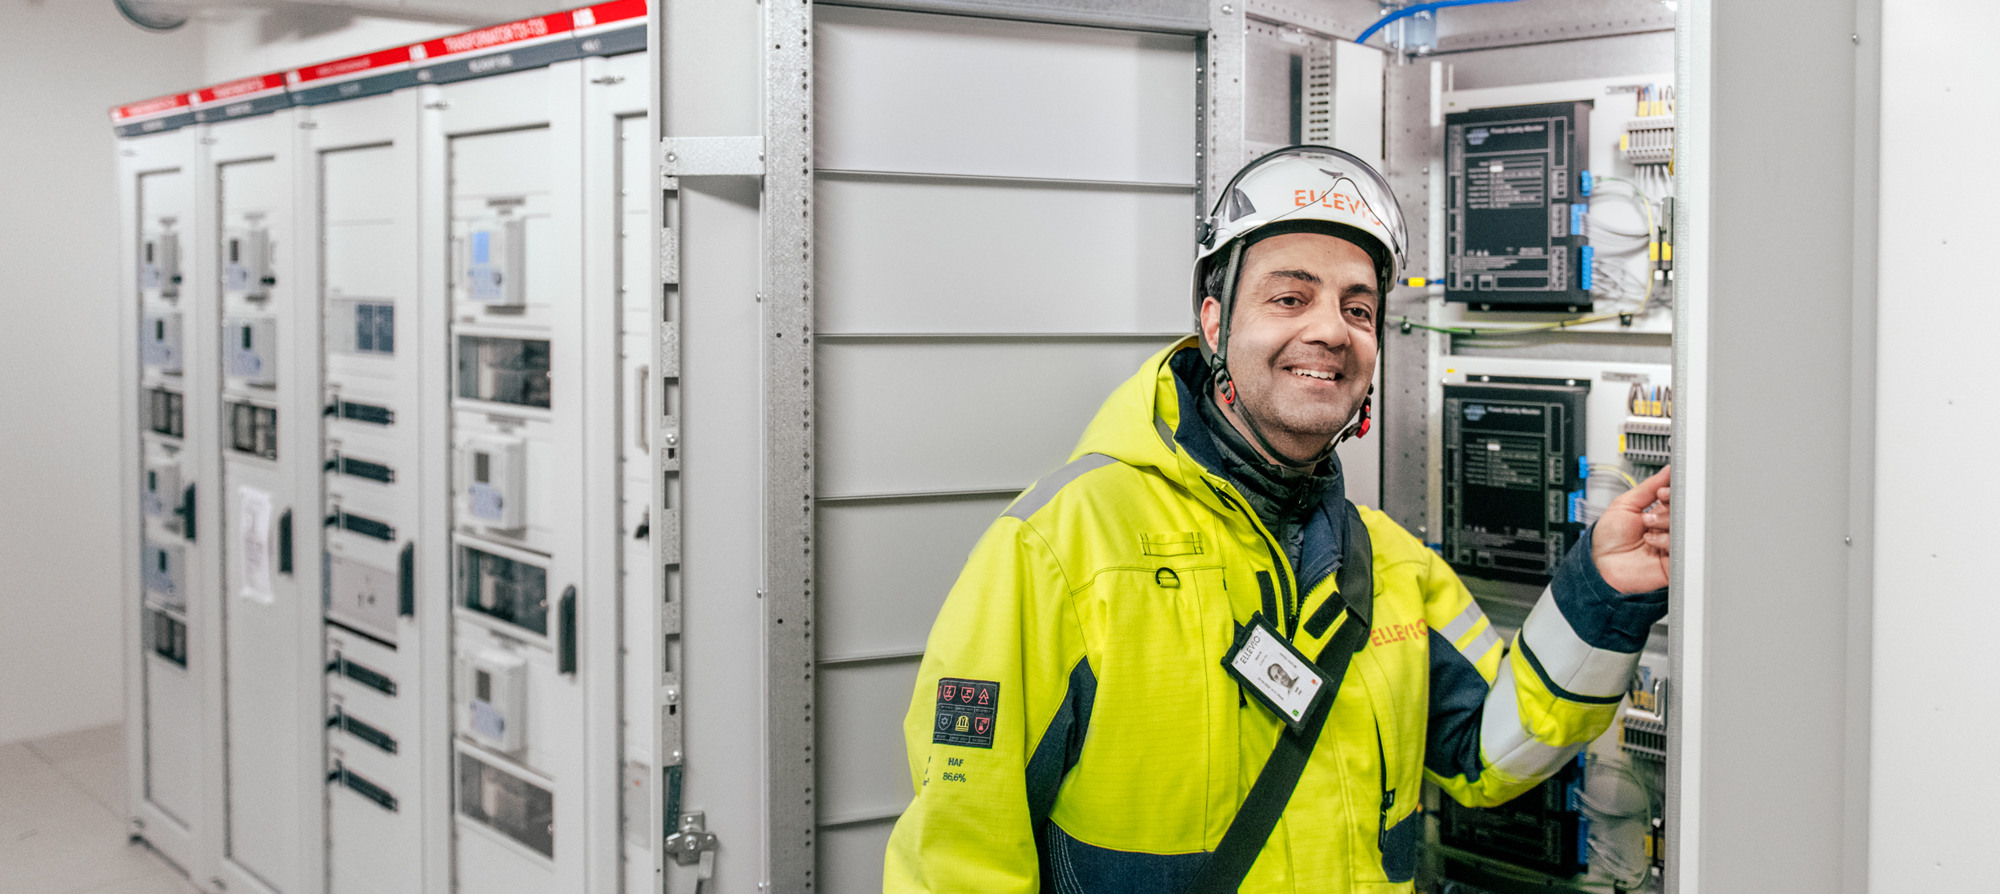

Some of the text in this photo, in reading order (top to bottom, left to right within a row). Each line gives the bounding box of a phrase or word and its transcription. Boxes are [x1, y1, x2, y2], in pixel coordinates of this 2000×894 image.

[1506, 126, 1524, 134] Quality
[1523, 125, 1545, 133] Monitor
[1370, 618, 1429, 647] ELLEVIO
[1239, 635, 1261, 665] ELLEVIO
[948, 757, 964, 767] HAF
[942, 772, 967, 783] 86,6%
